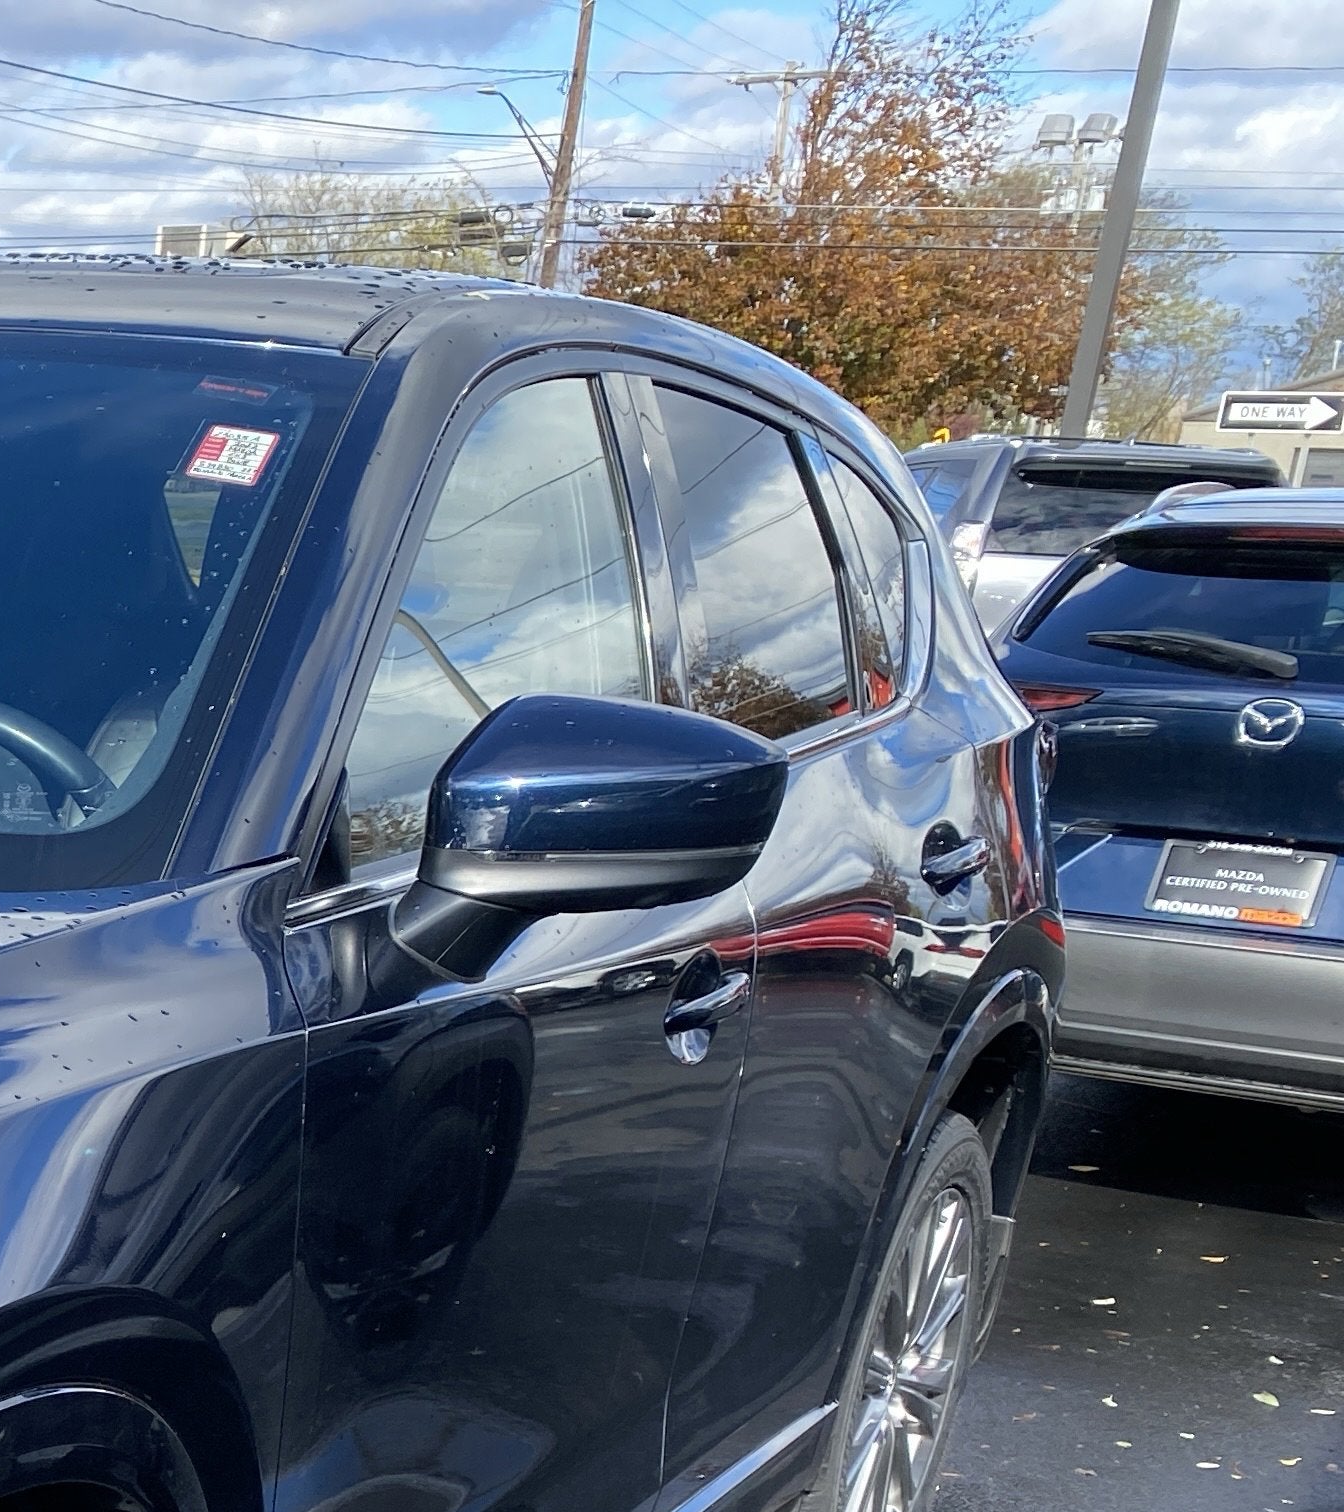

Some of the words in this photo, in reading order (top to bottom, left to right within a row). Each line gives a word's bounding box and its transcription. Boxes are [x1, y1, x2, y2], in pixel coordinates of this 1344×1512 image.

[1240, 405, 1270, 418] ONE
[1276, 405, 1308, 418] WAY
[1215, 868, 1265, 883] MAZDA
[1165, 875, 1226, 891] CERTIFIED
[1229, 881, 1310, 900] PRE-OWNED
[1153, 898, 1239, 919] ROMANO
